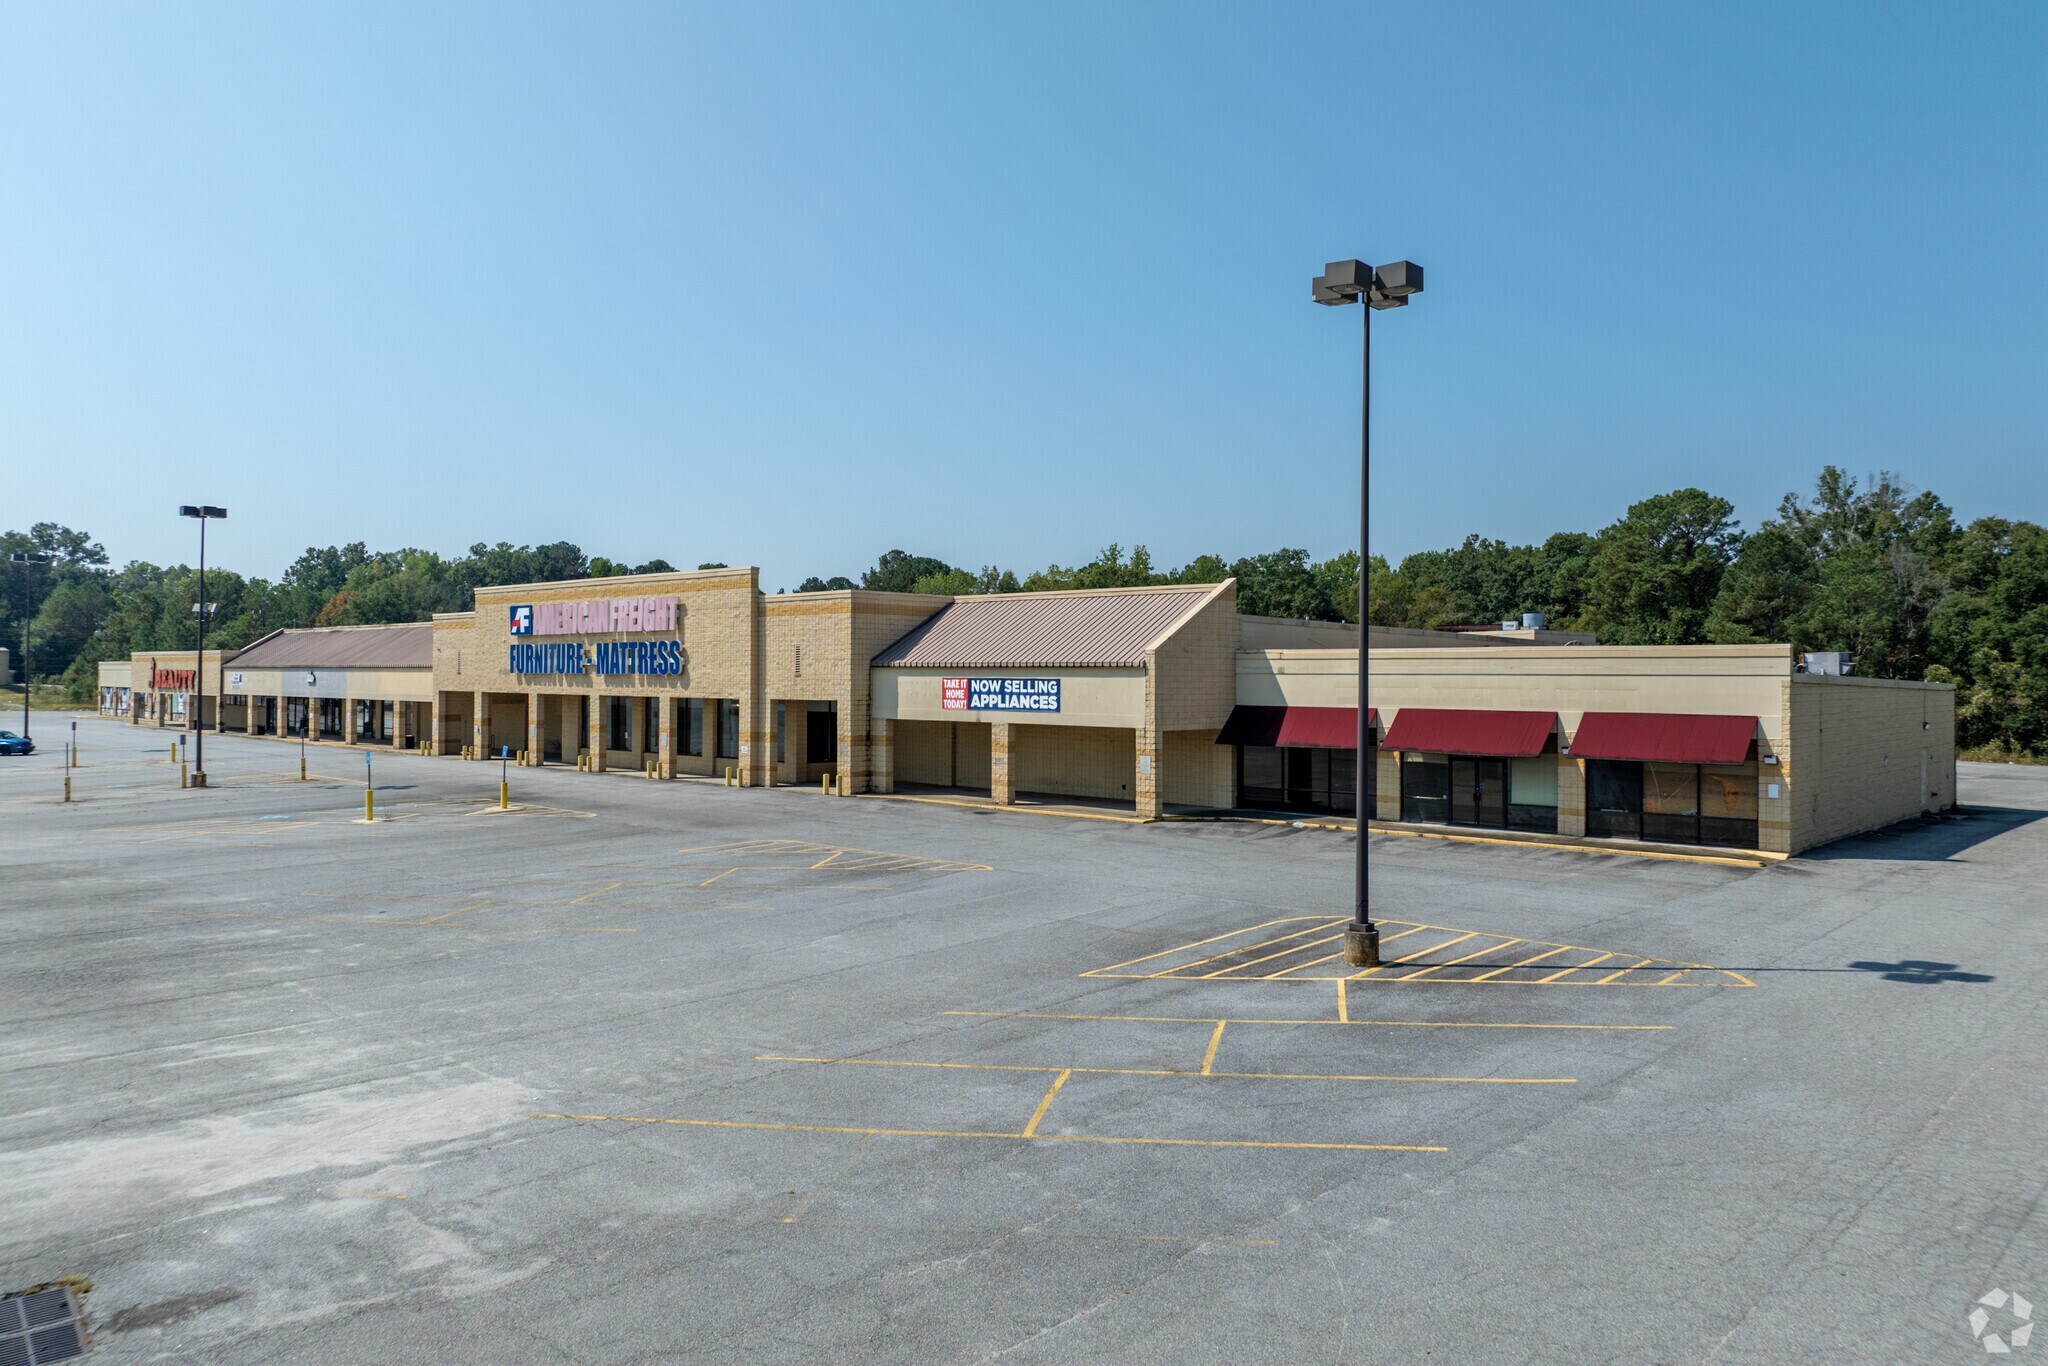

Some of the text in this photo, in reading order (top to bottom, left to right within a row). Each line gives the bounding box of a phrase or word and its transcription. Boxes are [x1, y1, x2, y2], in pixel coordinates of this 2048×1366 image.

[532, 597, 679, 635] AMERICAN FREIGHT
[510, 640, 682, 675] FURNITURE MATTRESS
[943, 679, 967, 688] TAKE IT
[971, 680, 1058, 693] NOW SELLING
[946, 689, 964, 699] HOME
[943, 699, 967, 709] TODAY!
[970, 694, 1058, 709] APPLIANCES
